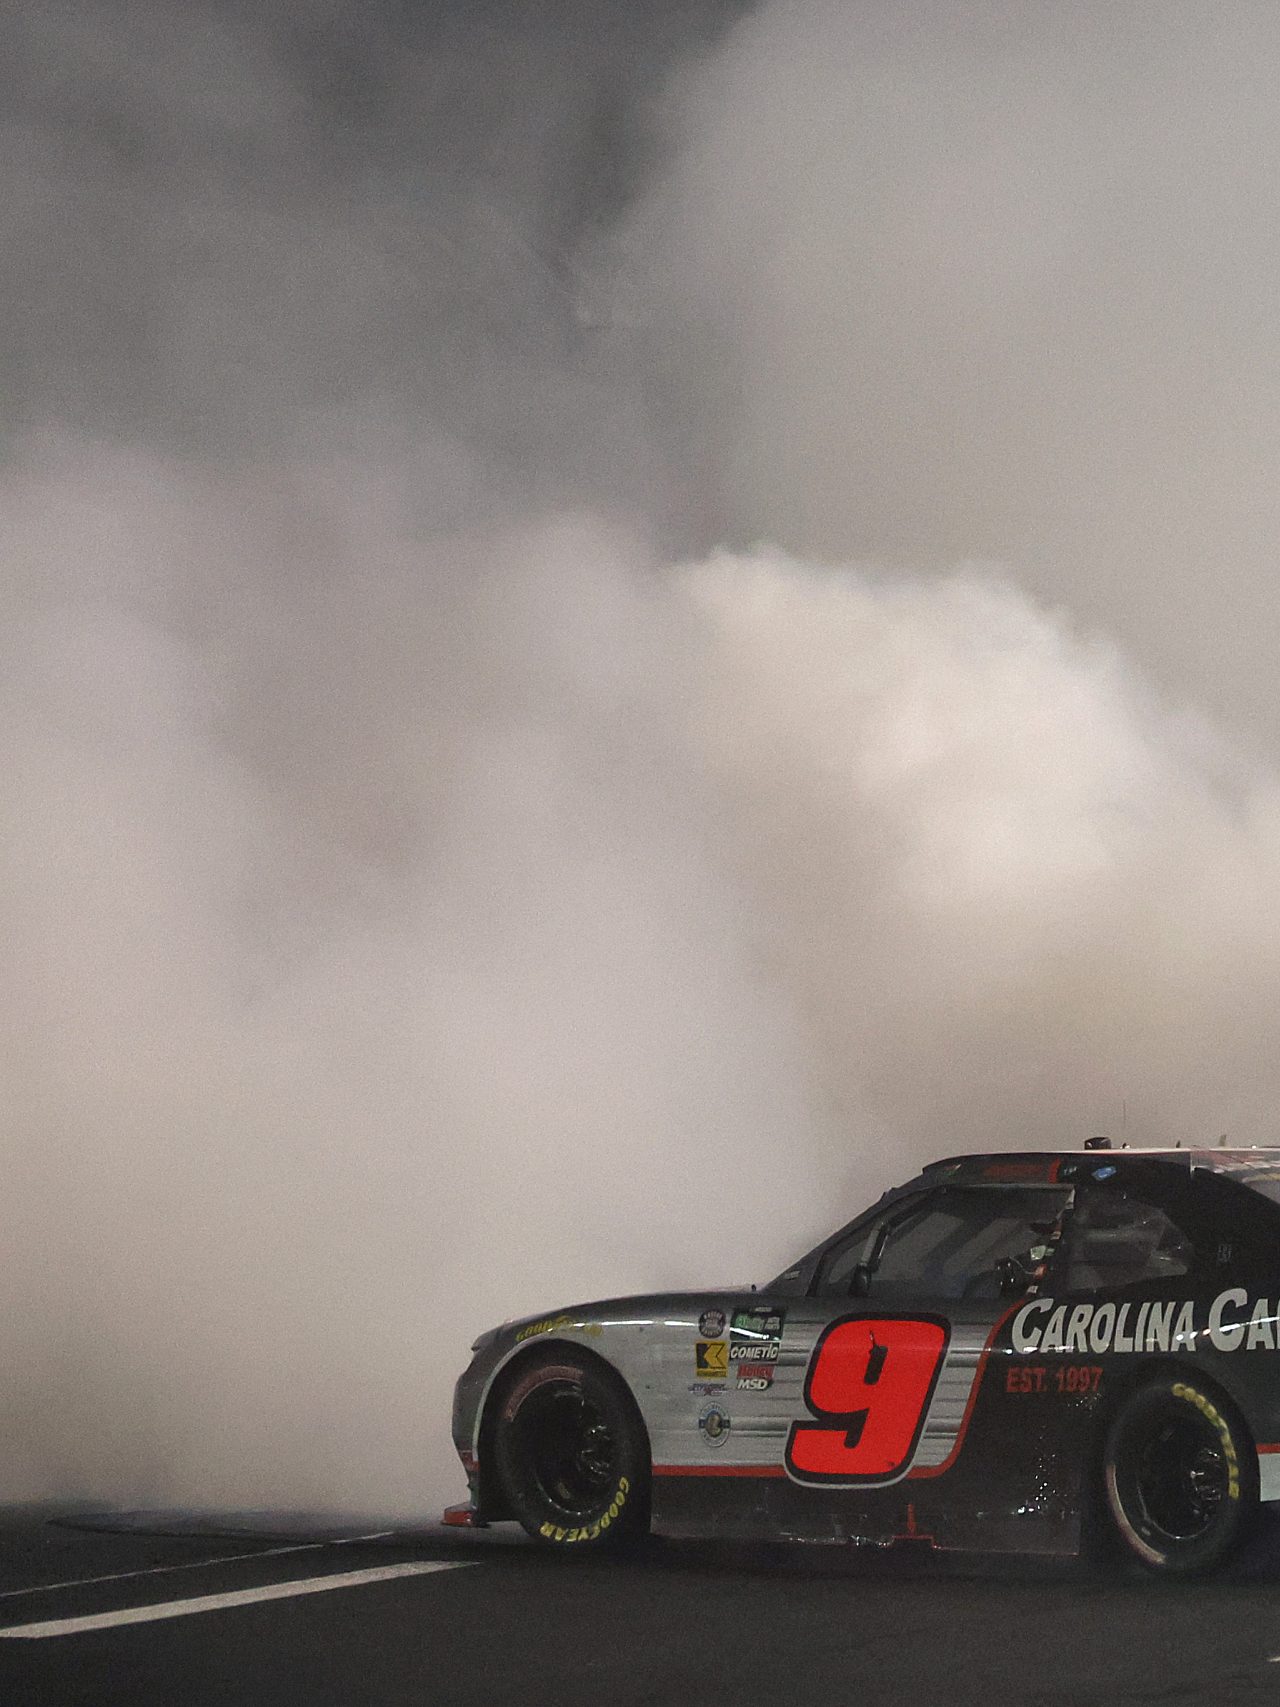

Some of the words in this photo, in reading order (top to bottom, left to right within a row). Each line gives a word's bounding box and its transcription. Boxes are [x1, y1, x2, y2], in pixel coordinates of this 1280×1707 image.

[1011, 1298, 1196, 1354] CAROLINA
[730, 1343, 778, 1359] COMETIC
[737, 1379, 768, 1390] MSD
[788, 1314, 948, 1480] 9
[1056, 1366, 1103, 1393] 1997
[540, 1477, 629, 1541] GOODYEAR
